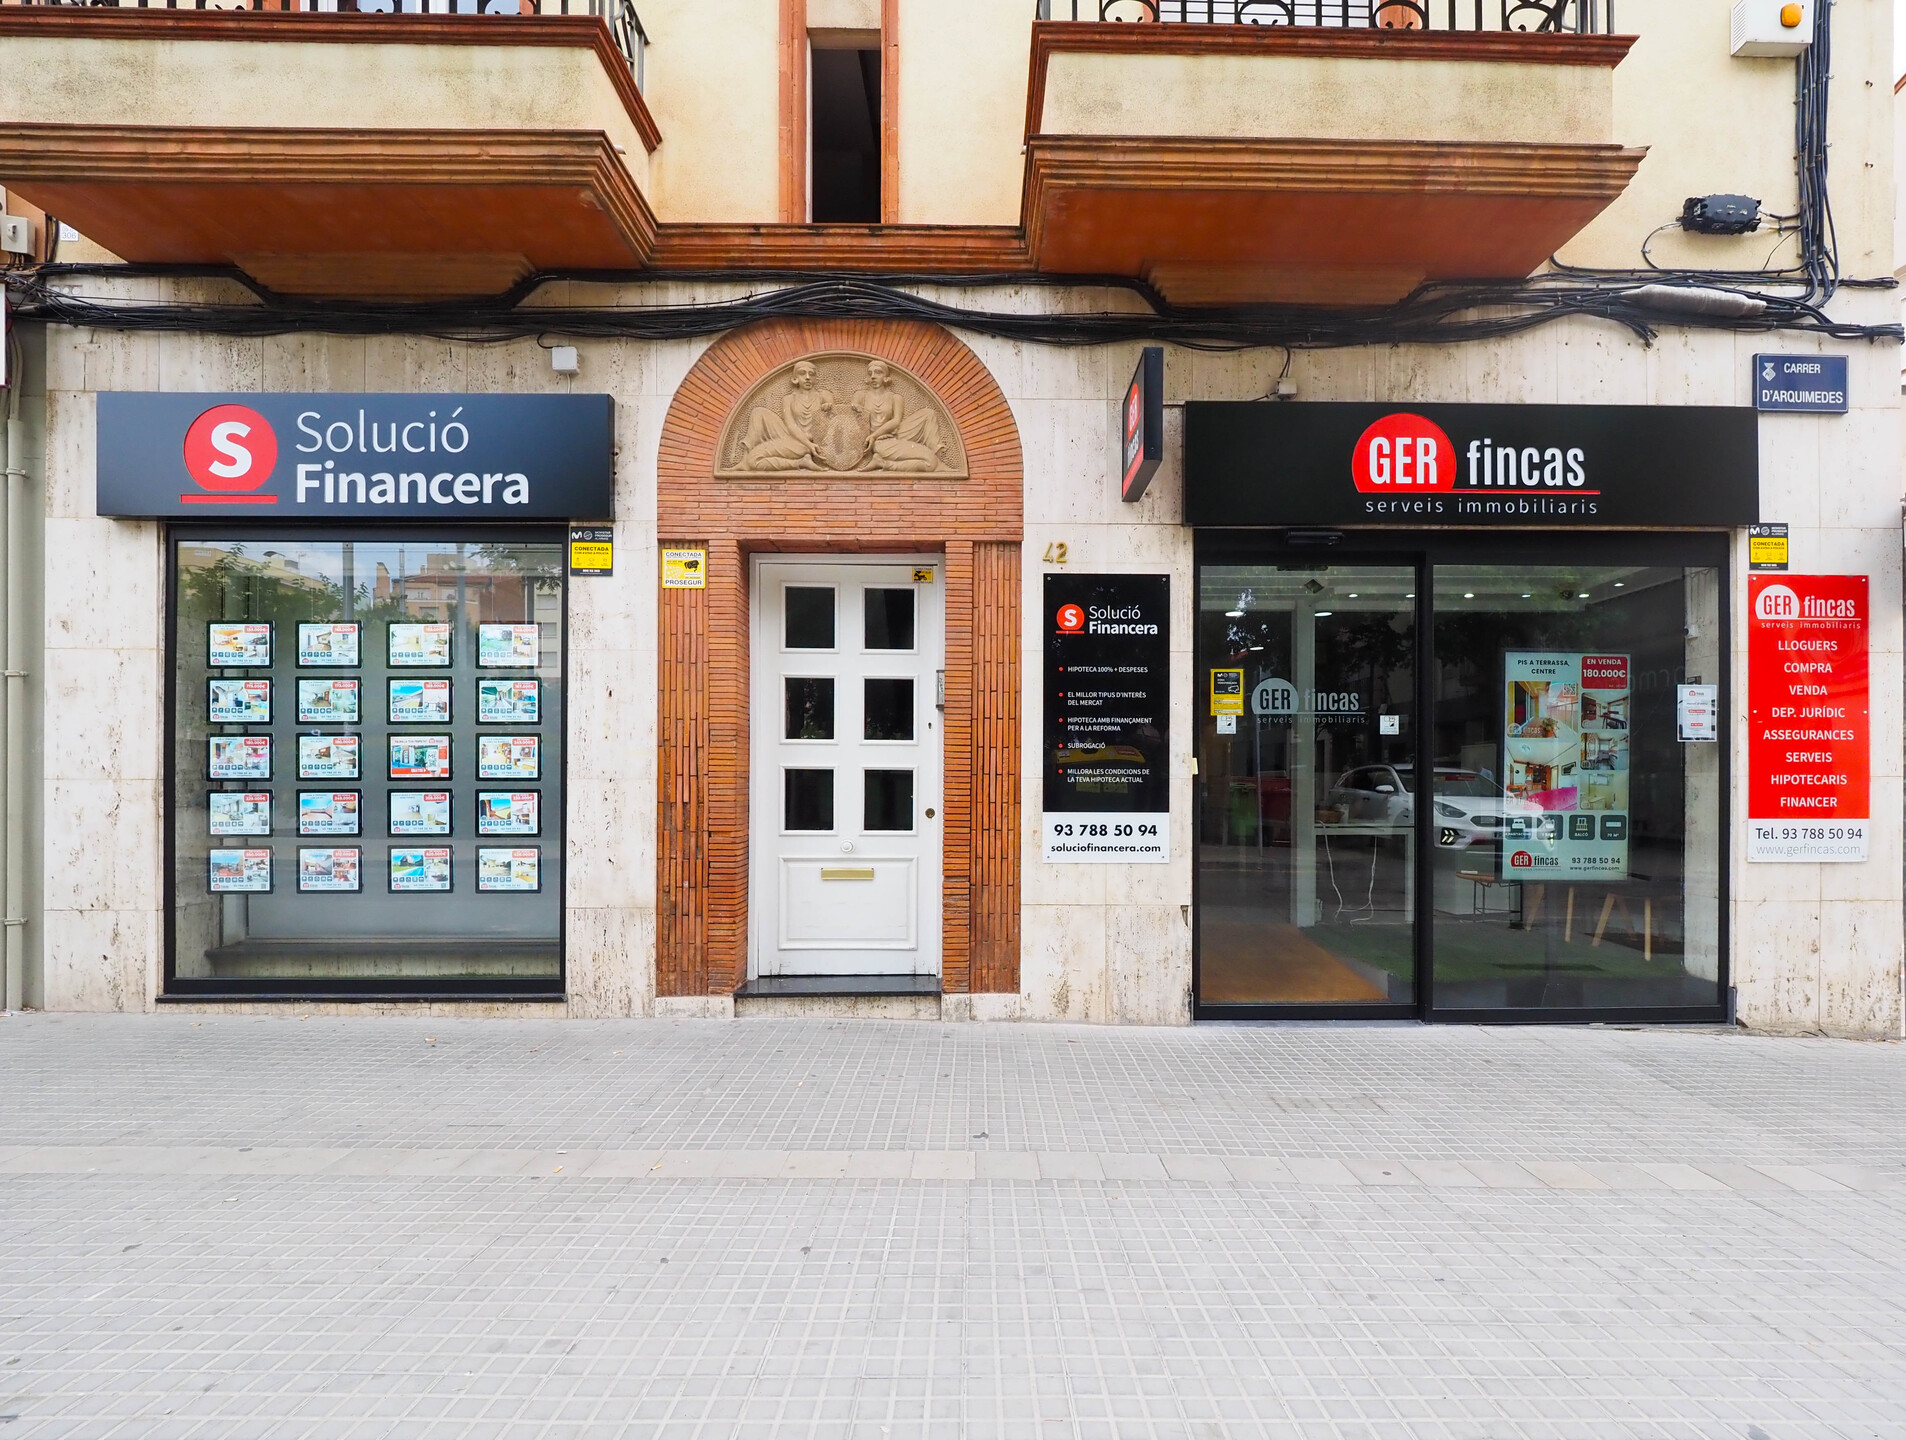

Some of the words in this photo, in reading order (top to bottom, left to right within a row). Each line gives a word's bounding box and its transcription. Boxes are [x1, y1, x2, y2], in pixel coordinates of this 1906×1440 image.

[1784, 363, 1820, 374] CARRER
[1762, 390, 1843, 404] D'ARQUIMEDES
[296, 407, 469, 454] Solució
[208, 421, 252, 478] S
[1369, 436, 1438, 485] GER
[1467, 440, 1586, 487] fincas
[296, 463, 530, 504] Financera
[1365, 499, 1443, 514] serveis
[1458, 498, 1597, 515] immobiliaris
[1043, 542, 1067, 563] 42
[1764, 595, 1792, 615] GER
[1804, 596, 1855, 617] fincas
[1064, 609, 1077, 627] S
[1089, 605, 1141, 620] Solució
[1089, 621, 1158, 635] Financera
[1761, 621, 1794, 629] serveis
[1800, 621, 1861, 629] immobiliaris
[1778, 640, 1838, 651] LLOGUERS
[1583, 669, 1626, 678] 180.000€
[1784, 663, 1832, 673] COMPRA
[1789, 685, 1828, 695] VENDA
[1260, 688, 1291, 710] GER
[1304, 689, 1359, 711] fincas
[1772, 707, 1797, 718] DEP.
[1800, 706, 1845, 718] JURÍDIC
[1111, 717, 1152, 725] FINANÇAMENT
[1257, 715, 1293, 724] serveis
[1763, 730, 1854, 740] ASSEGURANCES
[1786, 752, 1833, 763] SERVEIS
[1771, 774, 1848, 785] HIPOTECARIS
[1780, 797, 1837, 807] FINANCER
[1054, 824, 1073, 837] 93
[1079, 824, 1108, 837] 788
[1114, 824, 1133, 837] 50
[1138, 824, 1157, 837] 94
[1756, 828, 1778, 839] Tel.
[1782, 828, 1797, 839] 93
[1802, 828, 1825, 839] 788
[1828, 828, 1844, 839] 50
[1847, 828, 1862, 839] 94
[1051, 843, 1160, 853] soluciofinancera.com
[1756, 844, 1861, 857] www.gerfincas.com
[1515, 855, 1529, 866] GER
[1534, 855, 1559, 866] fincas
